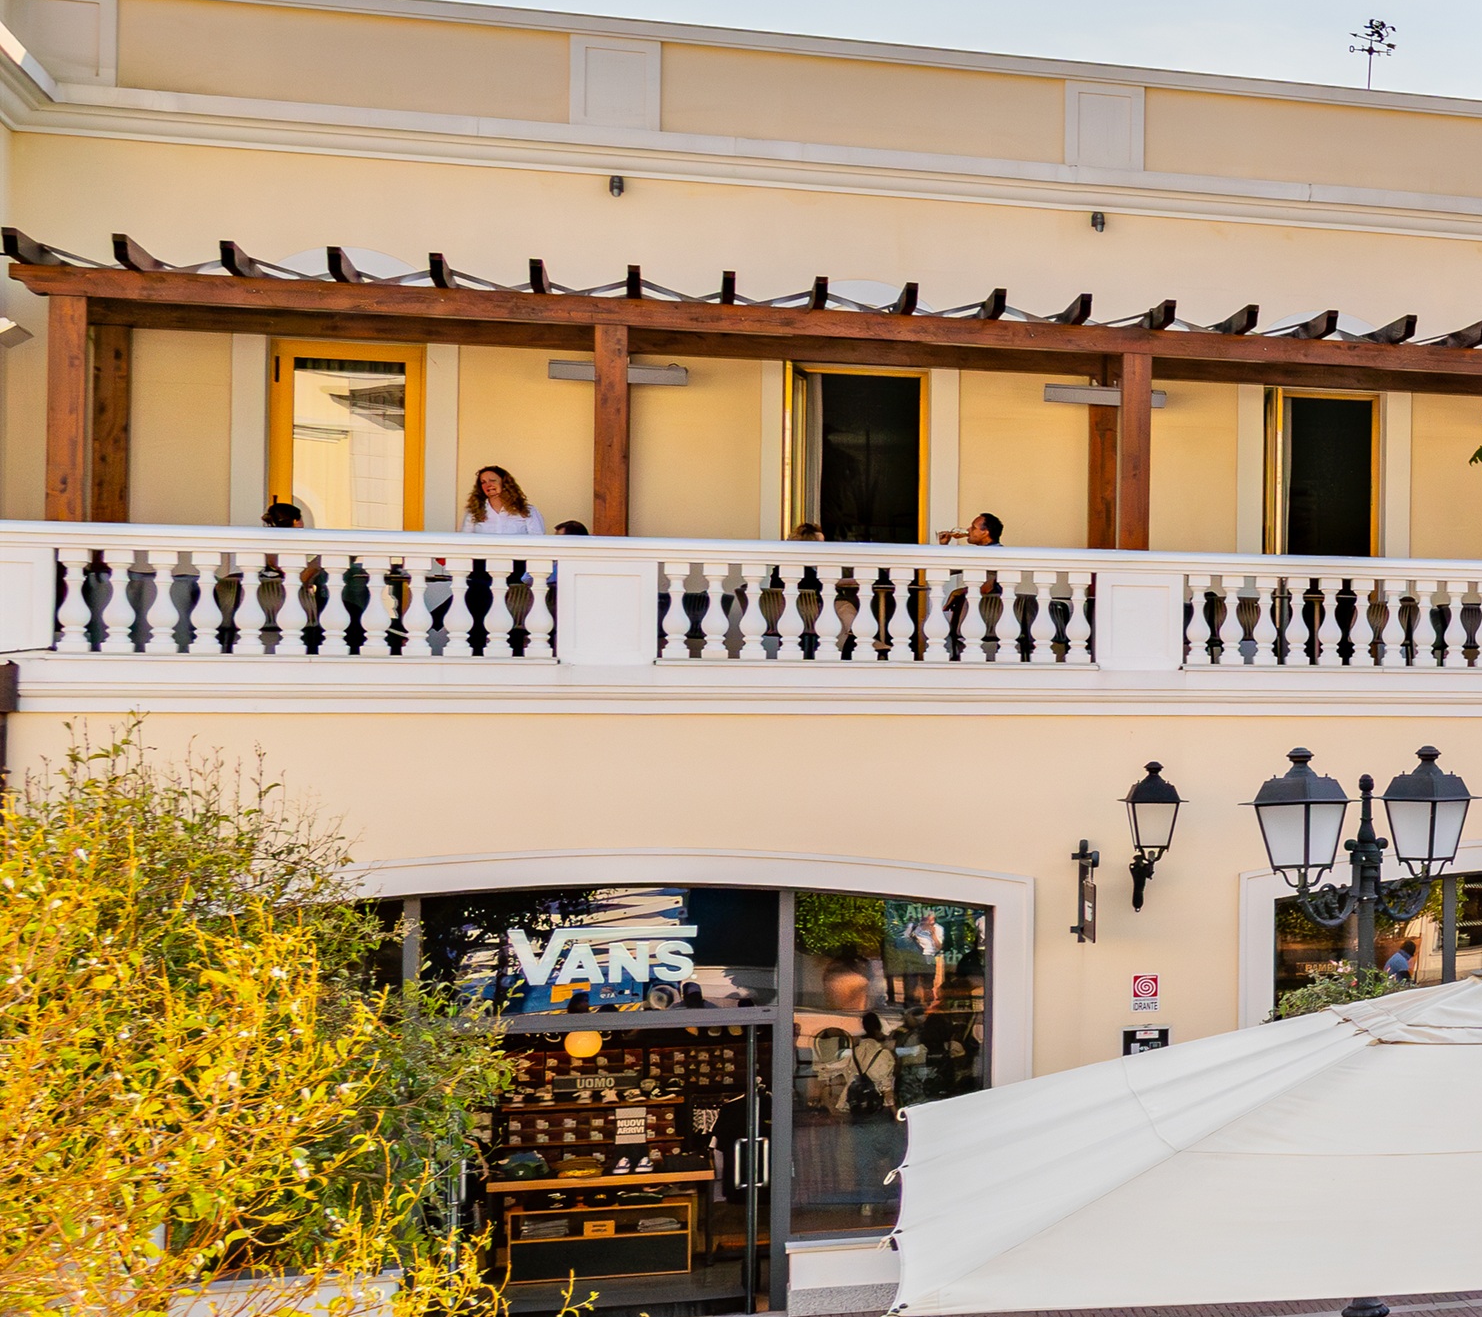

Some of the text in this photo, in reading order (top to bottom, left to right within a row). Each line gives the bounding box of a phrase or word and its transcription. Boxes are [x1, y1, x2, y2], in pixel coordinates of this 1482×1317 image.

[507, 926, 698, 986] VANS
[1132, 1001, 1158, 1011] IDRANTE
[576, 1077, 615, 1089] UOMO
[616, 1118, 645, 1128] NUOVI
